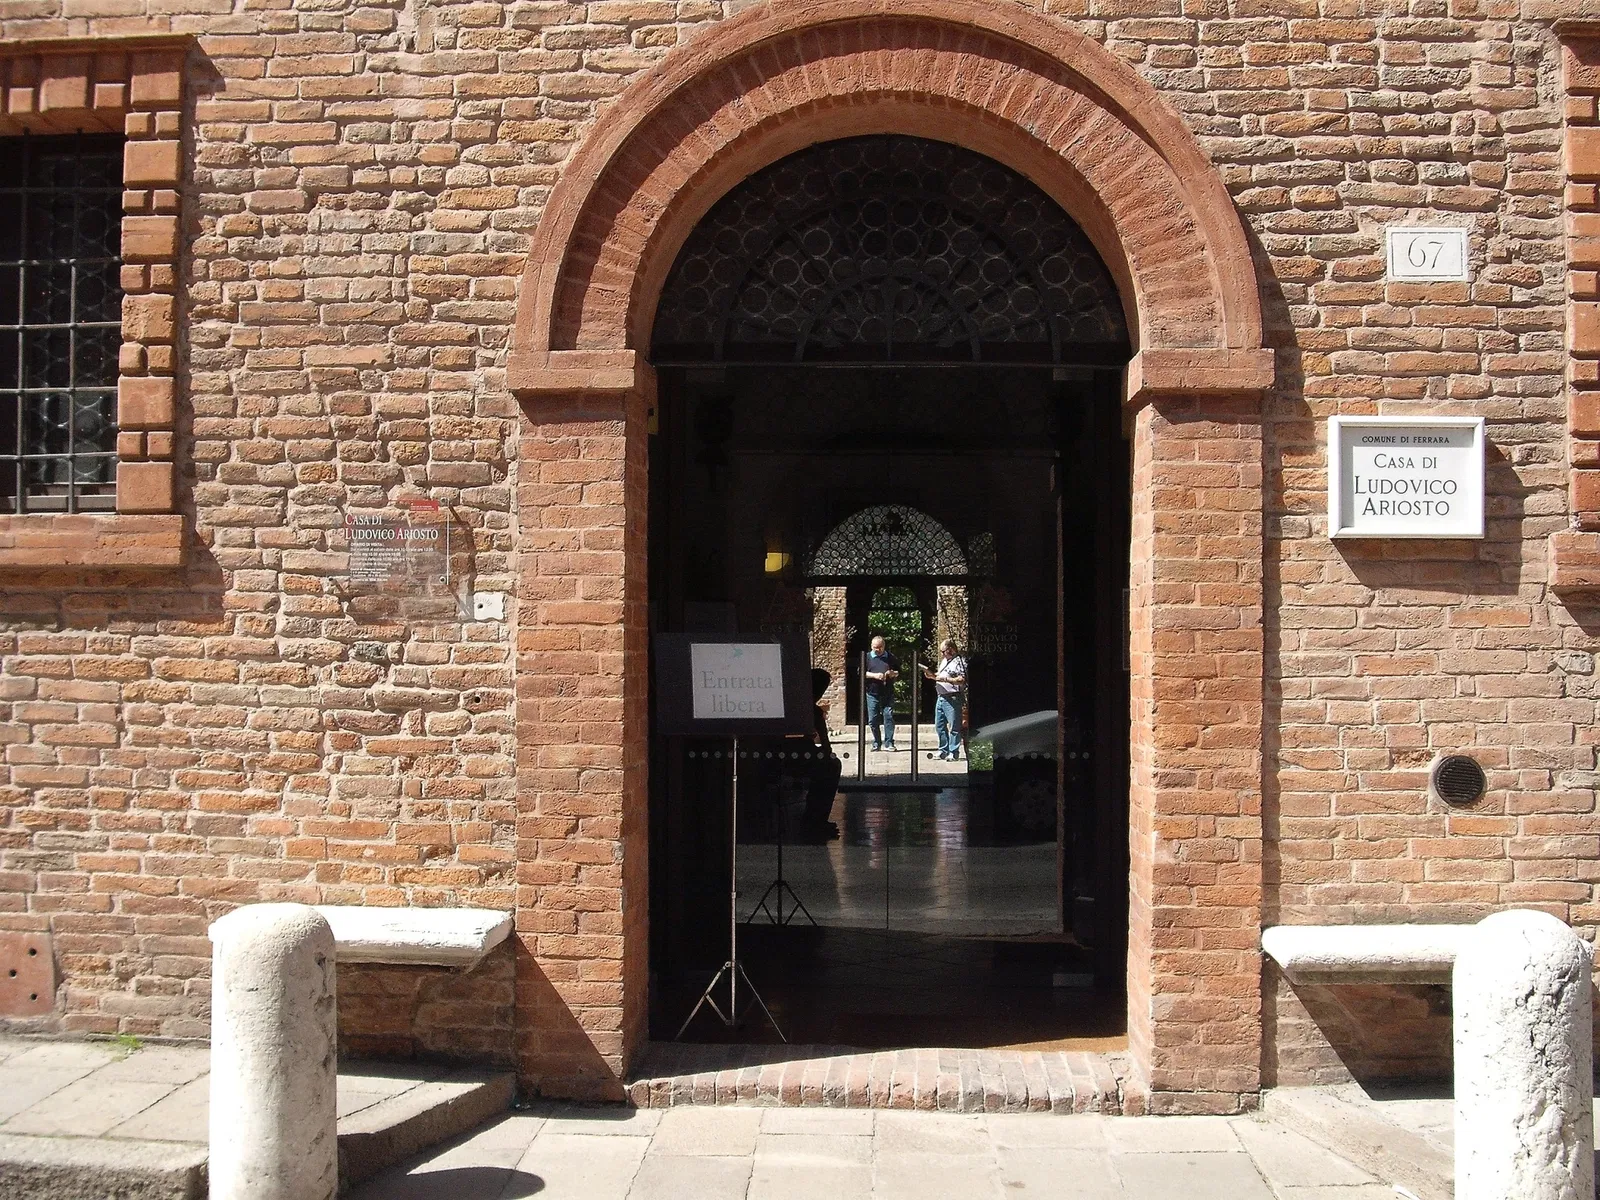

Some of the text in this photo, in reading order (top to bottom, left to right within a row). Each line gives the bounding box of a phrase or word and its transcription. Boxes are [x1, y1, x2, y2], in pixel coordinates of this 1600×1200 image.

[1407, 235, 1446, 270] 67
[1361, 436, 1450, 444] COMUNE DI FERRARA
[1373, 453, 1438, 469] CASA DI
[1354, 475, 1458, 495] LUDOVICO
[1361, 497, 1450, 516] ARIOSTO
[345, 513, 382, 526] CASA DI
[345, 527, 439, 540] LUDOVICO ARIOSTO
[701, 670, 774, 690] Entrata
[711, 694, 767, 714] libera
